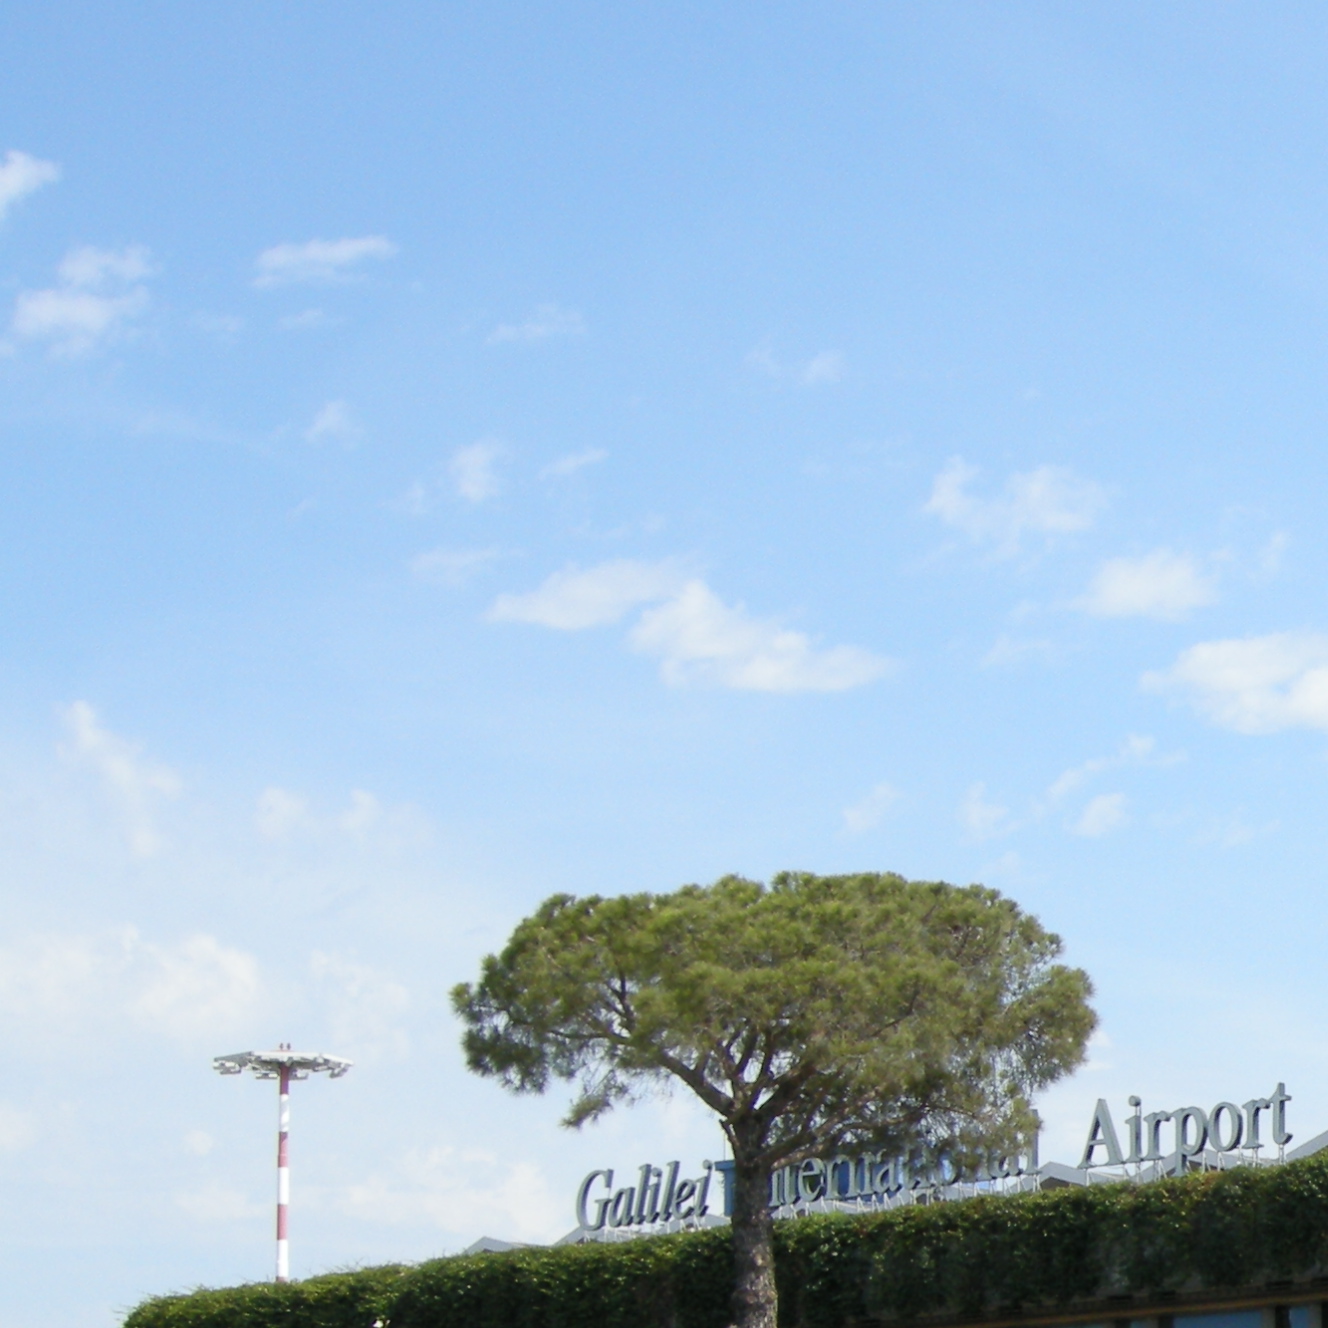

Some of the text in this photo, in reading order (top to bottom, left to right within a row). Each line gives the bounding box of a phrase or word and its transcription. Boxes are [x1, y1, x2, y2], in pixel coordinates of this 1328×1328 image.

[575, 1082, 1293, 1231] Galilei nternatioal Airport
